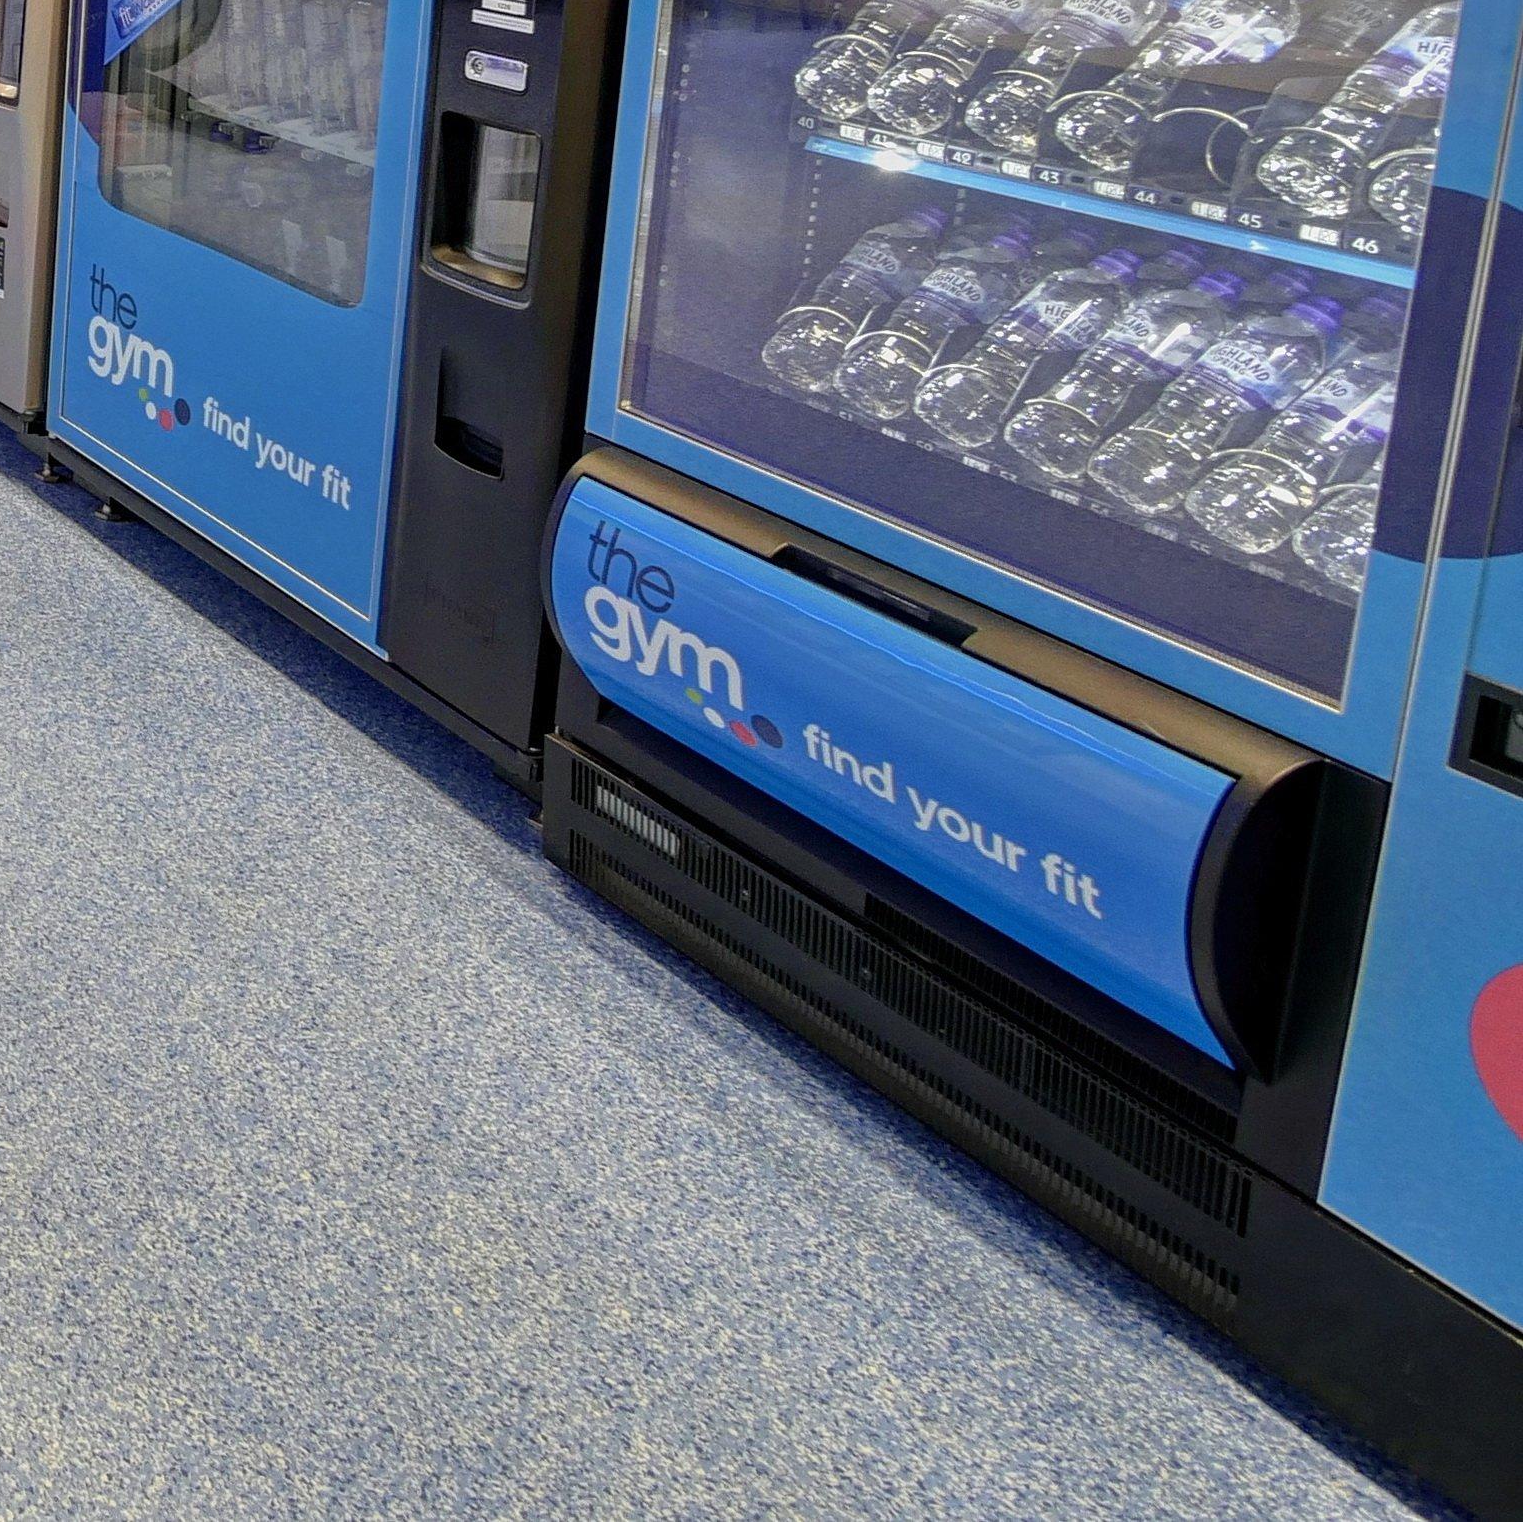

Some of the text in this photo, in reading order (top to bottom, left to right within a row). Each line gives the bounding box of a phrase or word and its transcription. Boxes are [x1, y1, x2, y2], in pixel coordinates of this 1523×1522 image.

[797, 117, 814, 129] 40
[953, 152, 971, 165] 42
[1039, 171, 1059, 184] 43
[1134, 191, 1156, 205] 44
[1238, 212, 1262, 229] 45
[1352, 238, 1379, 255] 46
[90, 263, 138, 330] the
[87, 315, 174, 398] gym
[202, 396, 352, 511] find your fit
[587, 520, 675, 614] the
[583, 585, 743, 712] gym
[802, 723, 1104, 920] find your fit
